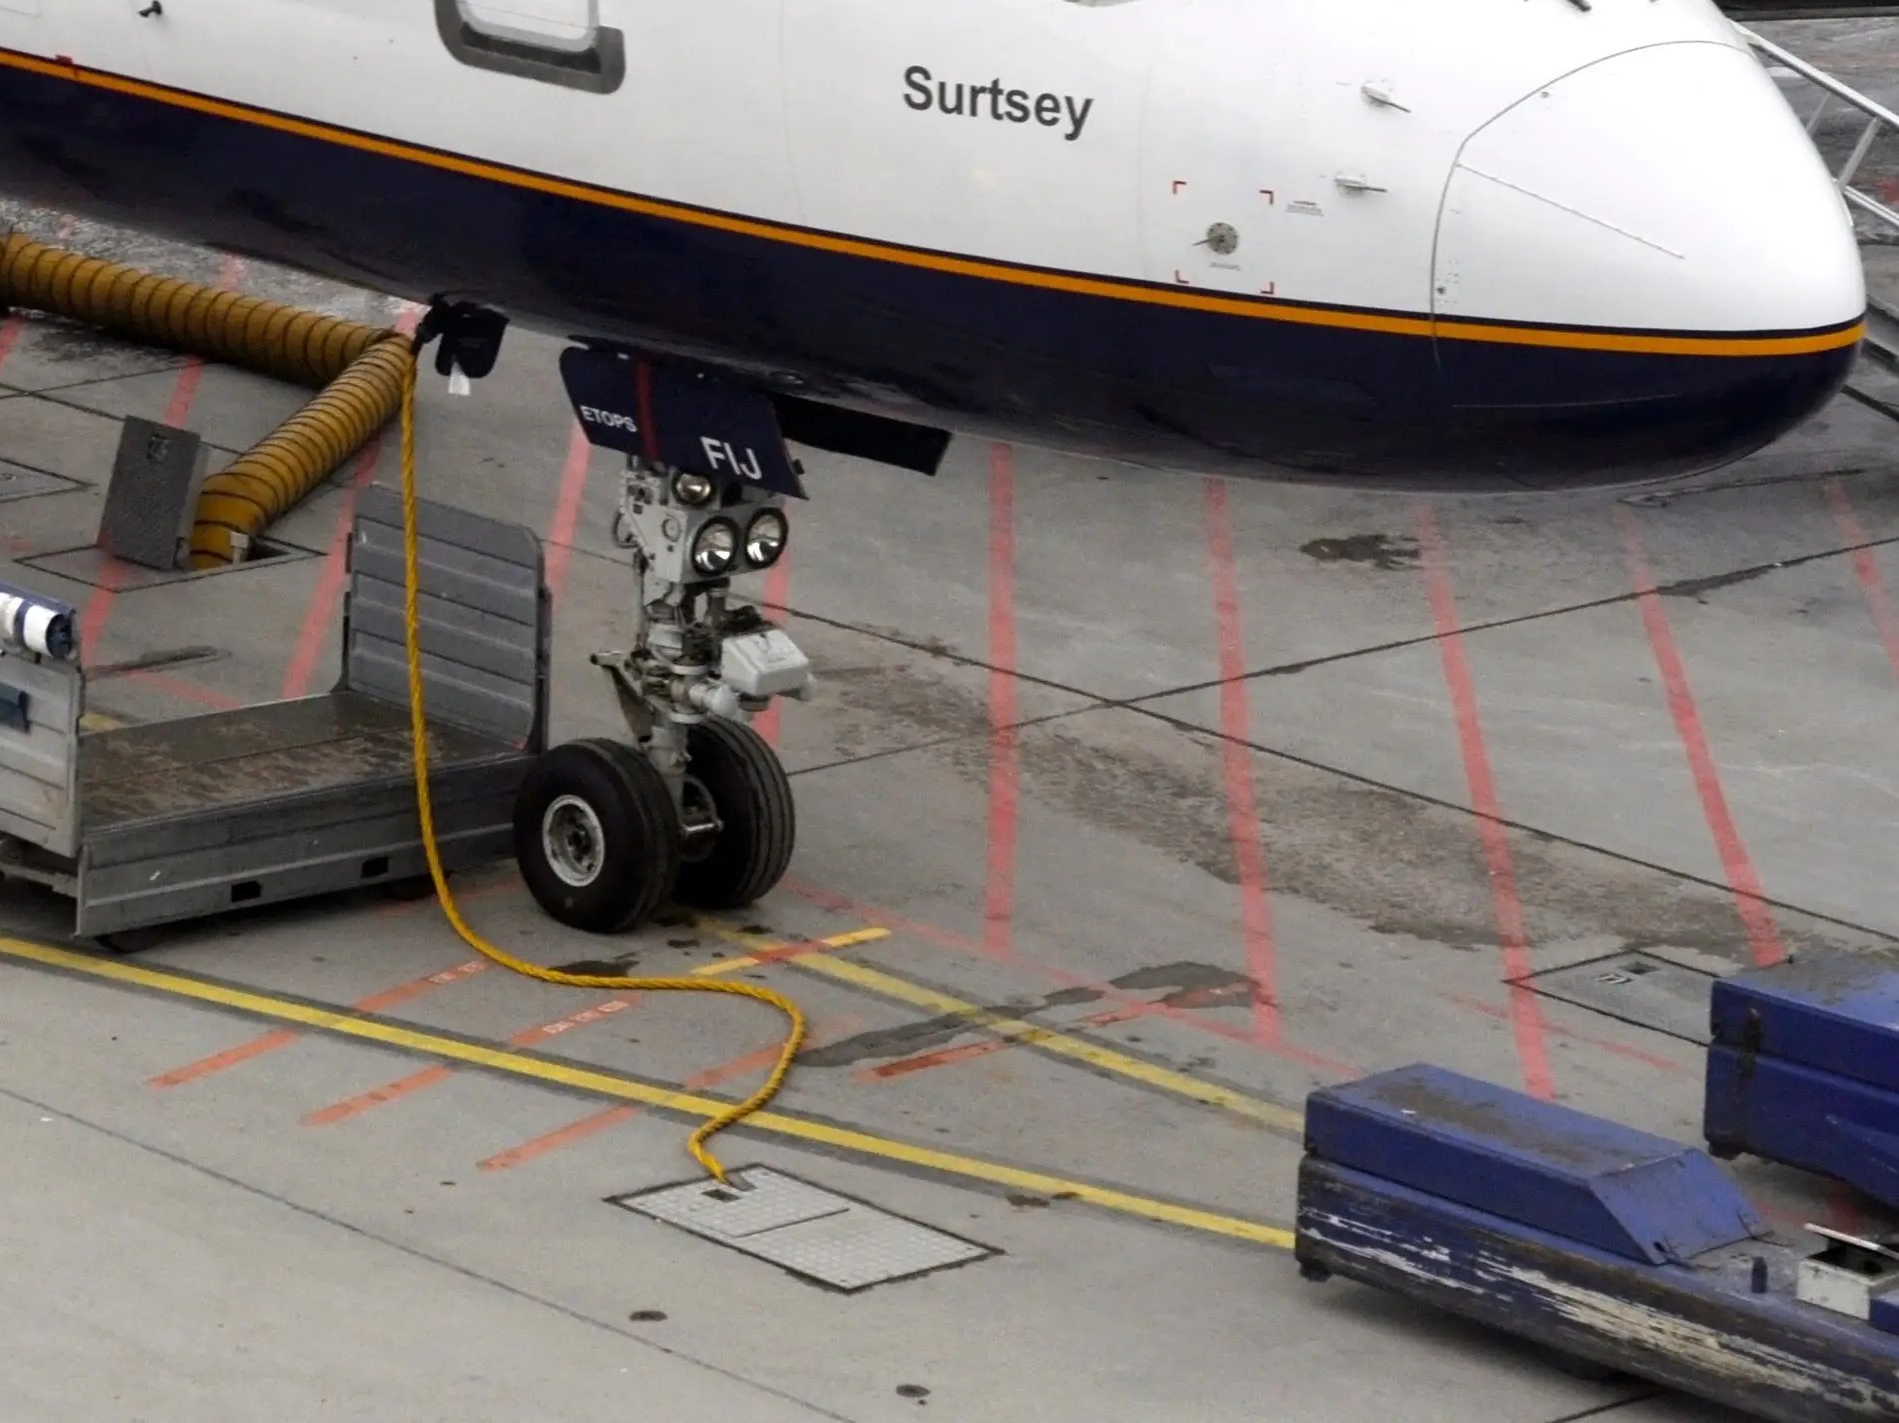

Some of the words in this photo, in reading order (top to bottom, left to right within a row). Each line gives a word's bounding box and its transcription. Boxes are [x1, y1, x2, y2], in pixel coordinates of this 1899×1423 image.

[902, 65, 1093, 140] Surtsey
[580, 405, 638, 432] ETOPS
[700, 436, 763, 480] FIJ
